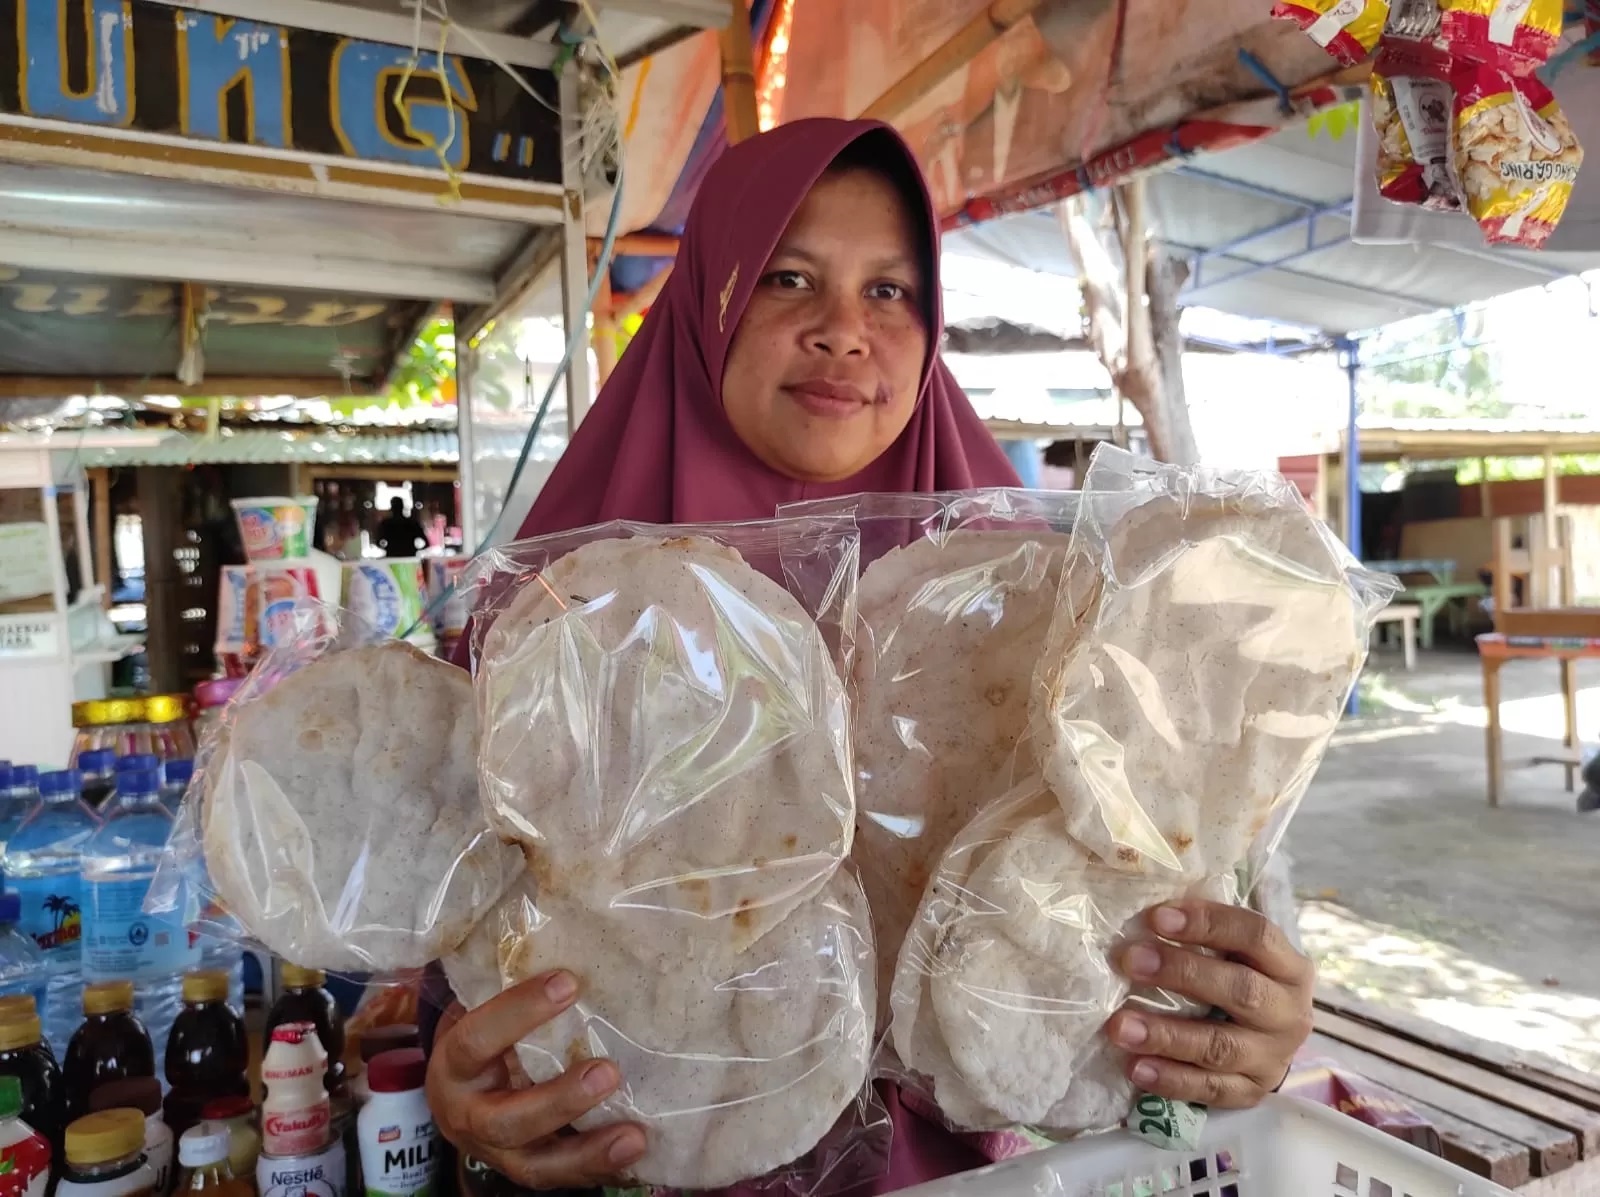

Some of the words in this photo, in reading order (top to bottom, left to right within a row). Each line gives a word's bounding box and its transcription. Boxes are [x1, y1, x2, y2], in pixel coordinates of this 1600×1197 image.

[274, 1113, 321, 1132] Yakult
[1137, 1095, 1172, 1137] 20
[271, 1165, 323, 1185] Nestlé
